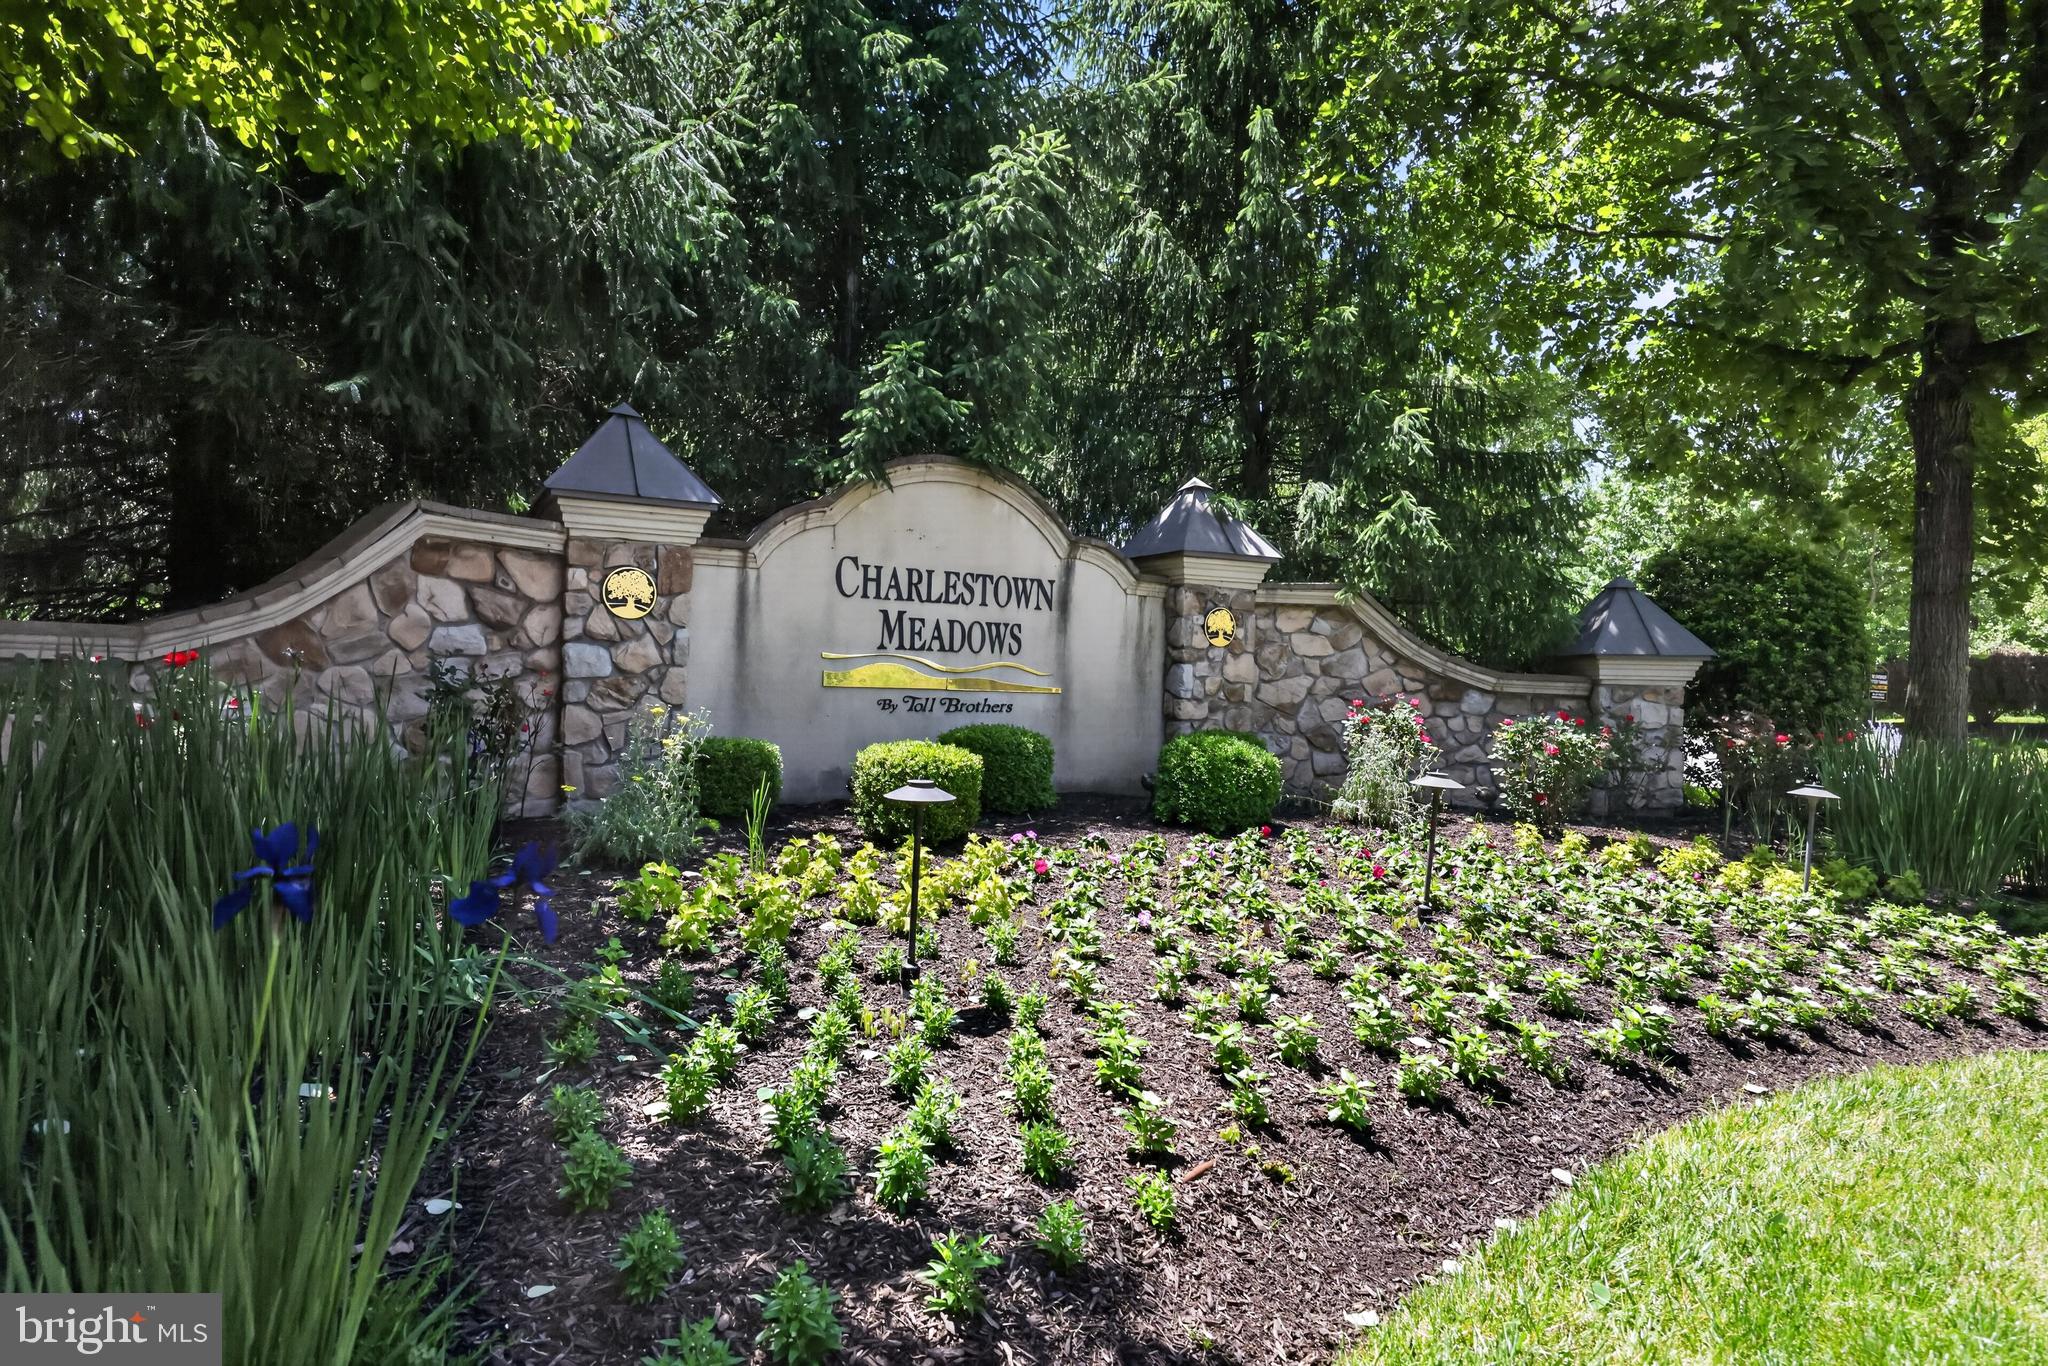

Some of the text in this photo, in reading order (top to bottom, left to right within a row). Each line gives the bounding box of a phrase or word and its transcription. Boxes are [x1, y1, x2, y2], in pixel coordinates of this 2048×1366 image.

[835, 555, 1056, 612] CHARLESTOWN
[876, 609, 1023, 656] MEADOWS
[876, 695, 1014, 714] By Toll Brothers
